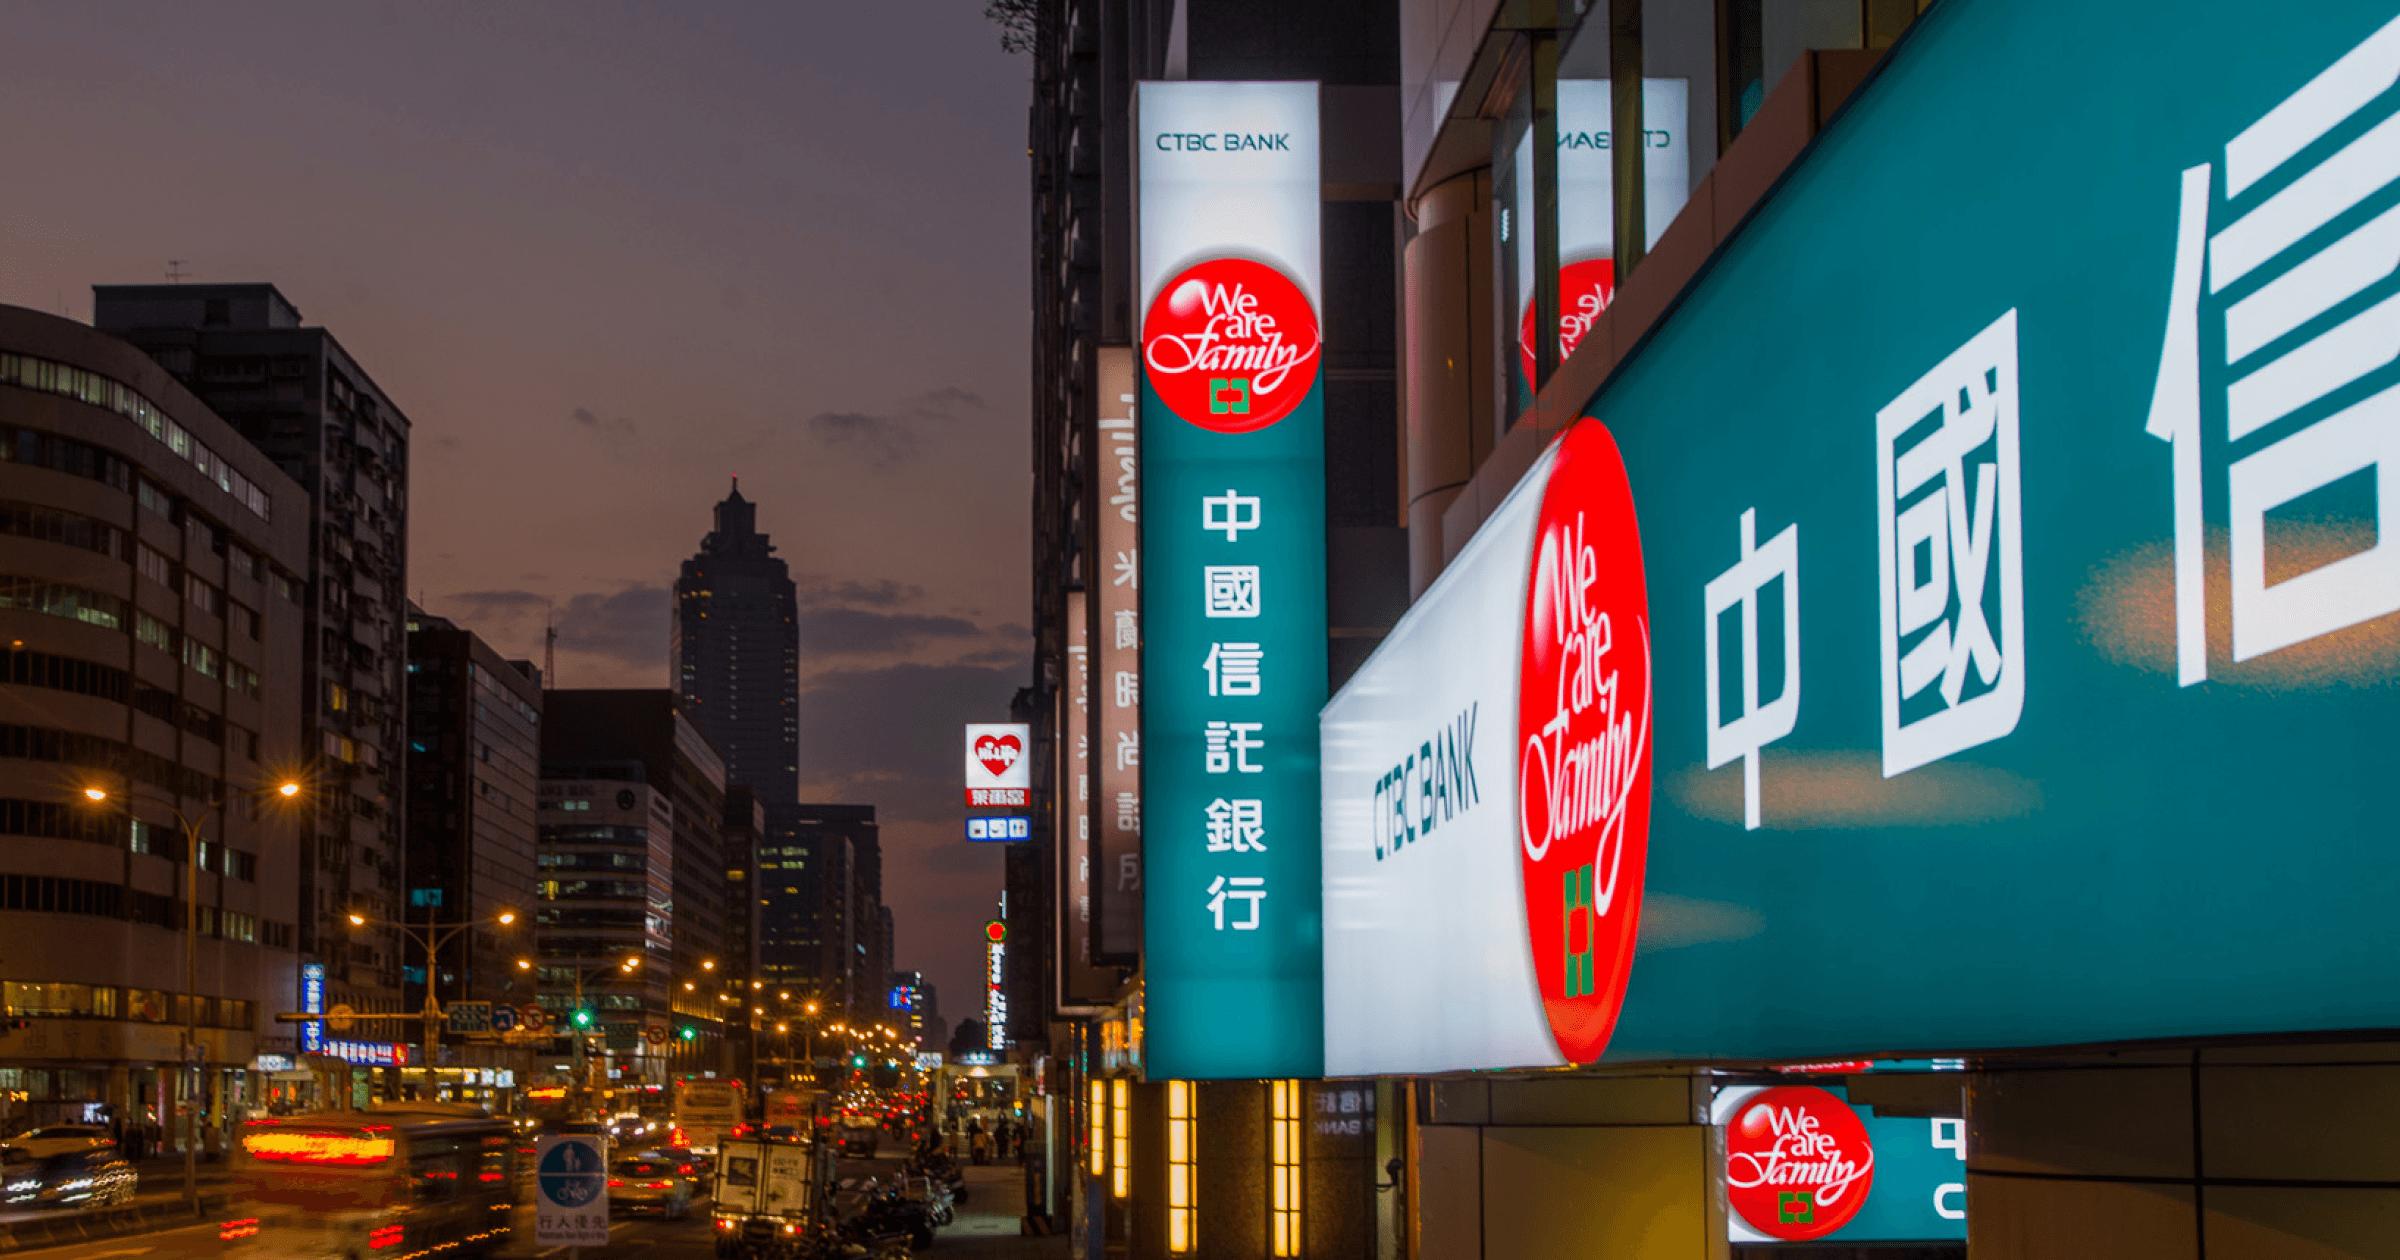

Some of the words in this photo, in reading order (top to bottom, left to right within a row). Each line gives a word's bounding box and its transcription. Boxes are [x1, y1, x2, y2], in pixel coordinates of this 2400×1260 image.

[1156, 133, 1218, 151] CTBC
[1224, 133, 1290, 151] BANK
[1194, 282, 1259, 318] We
[1225, 312, 1276, 342] are
[1544, 511, 1597, 646] We
[1571, 612, 1612, 715] are
[1202, 489, 1267, 931] 中國信託銀行
[1374, 754, 1415, 861] CTBC
[1420, 699, 1479, 837] BANK
[1762, 1105, 1819, 1136] We
[1790, 1132, 1836, 1157] are
